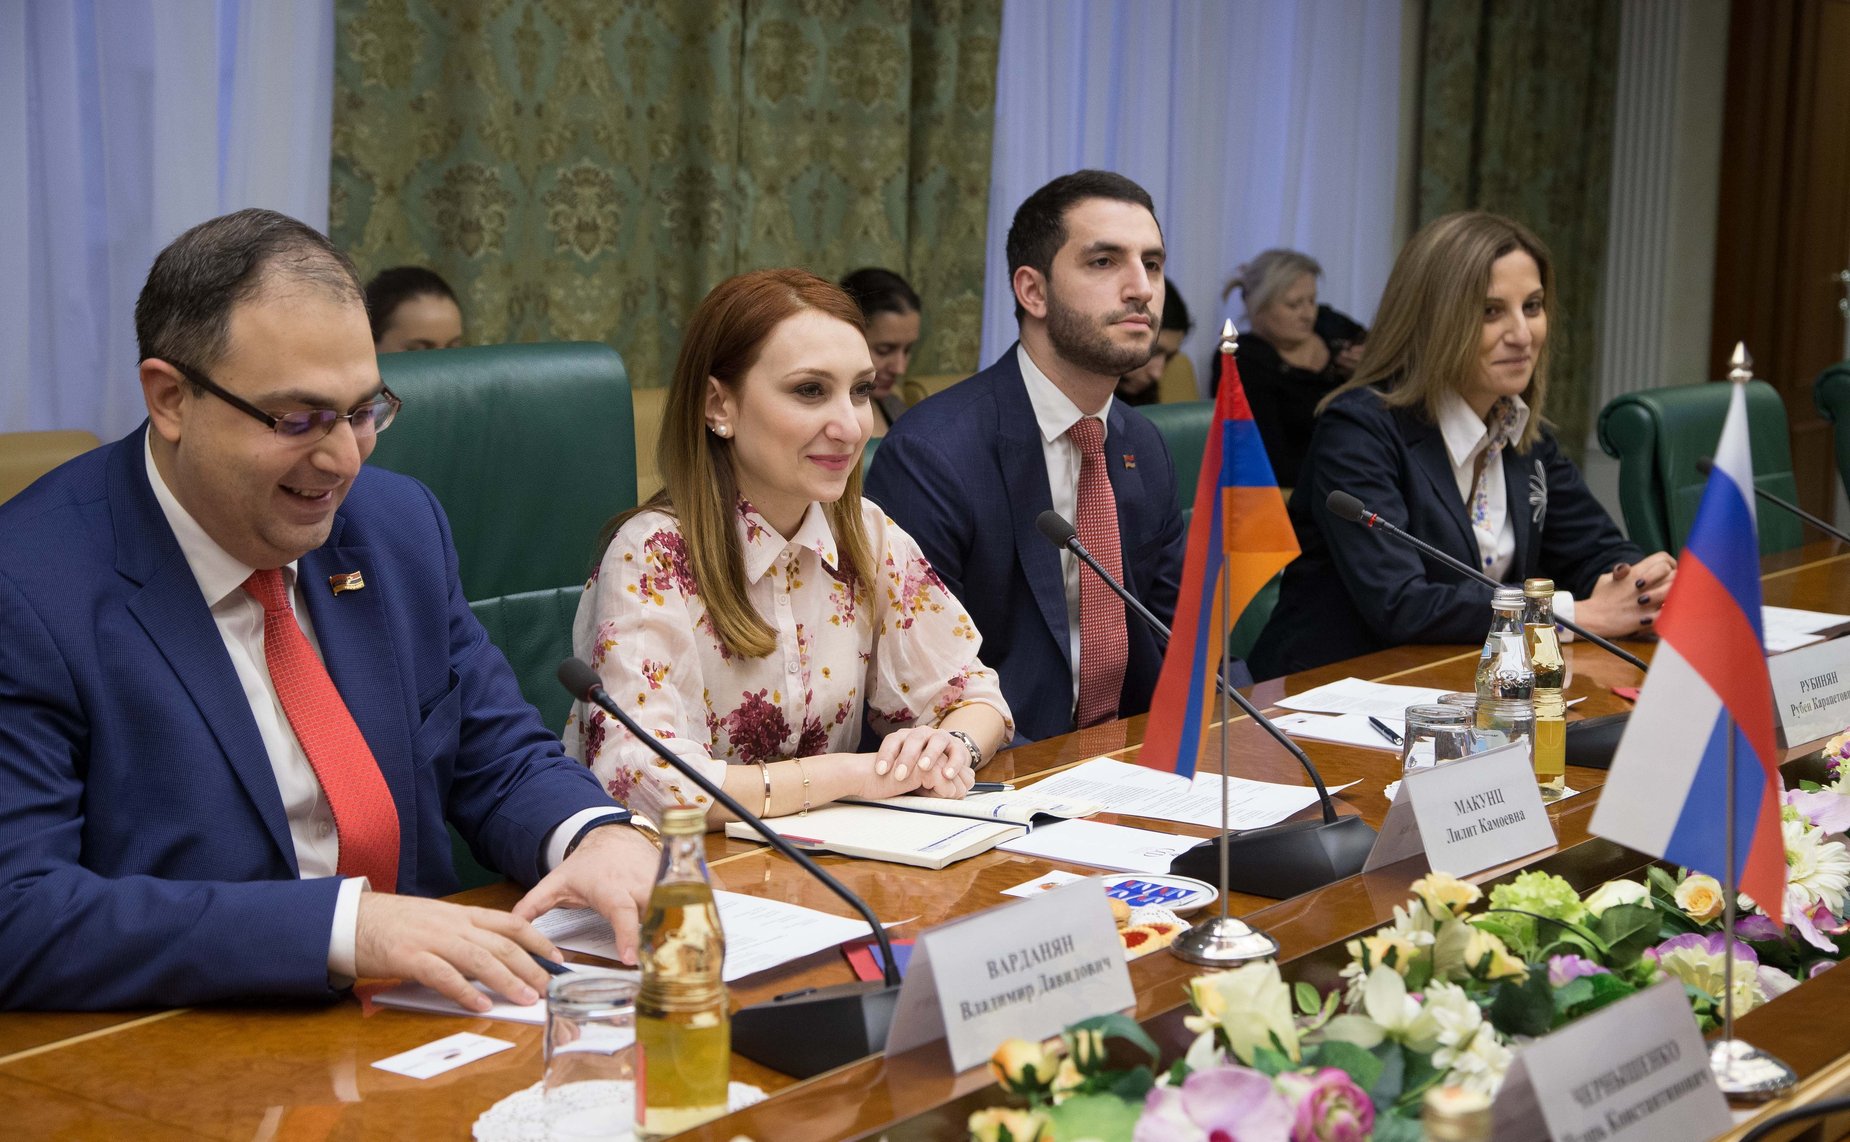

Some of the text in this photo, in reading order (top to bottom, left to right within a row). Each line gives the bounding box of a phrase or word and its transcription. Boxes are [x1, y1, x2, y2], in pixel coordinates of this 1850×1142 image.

[1800, 671, 1839, 693] РУБИНЯН
[1790, 701, 1812, 719] Рубен
[1454, 788, 1505, 816] МАКУНЦ
[1446, 809, 1526, 844] Лилит Камоевна
[986, 934, 1075, 979] ВАРДАНЯН
[959, 957, 1112, 1021] Владимир Давидович
